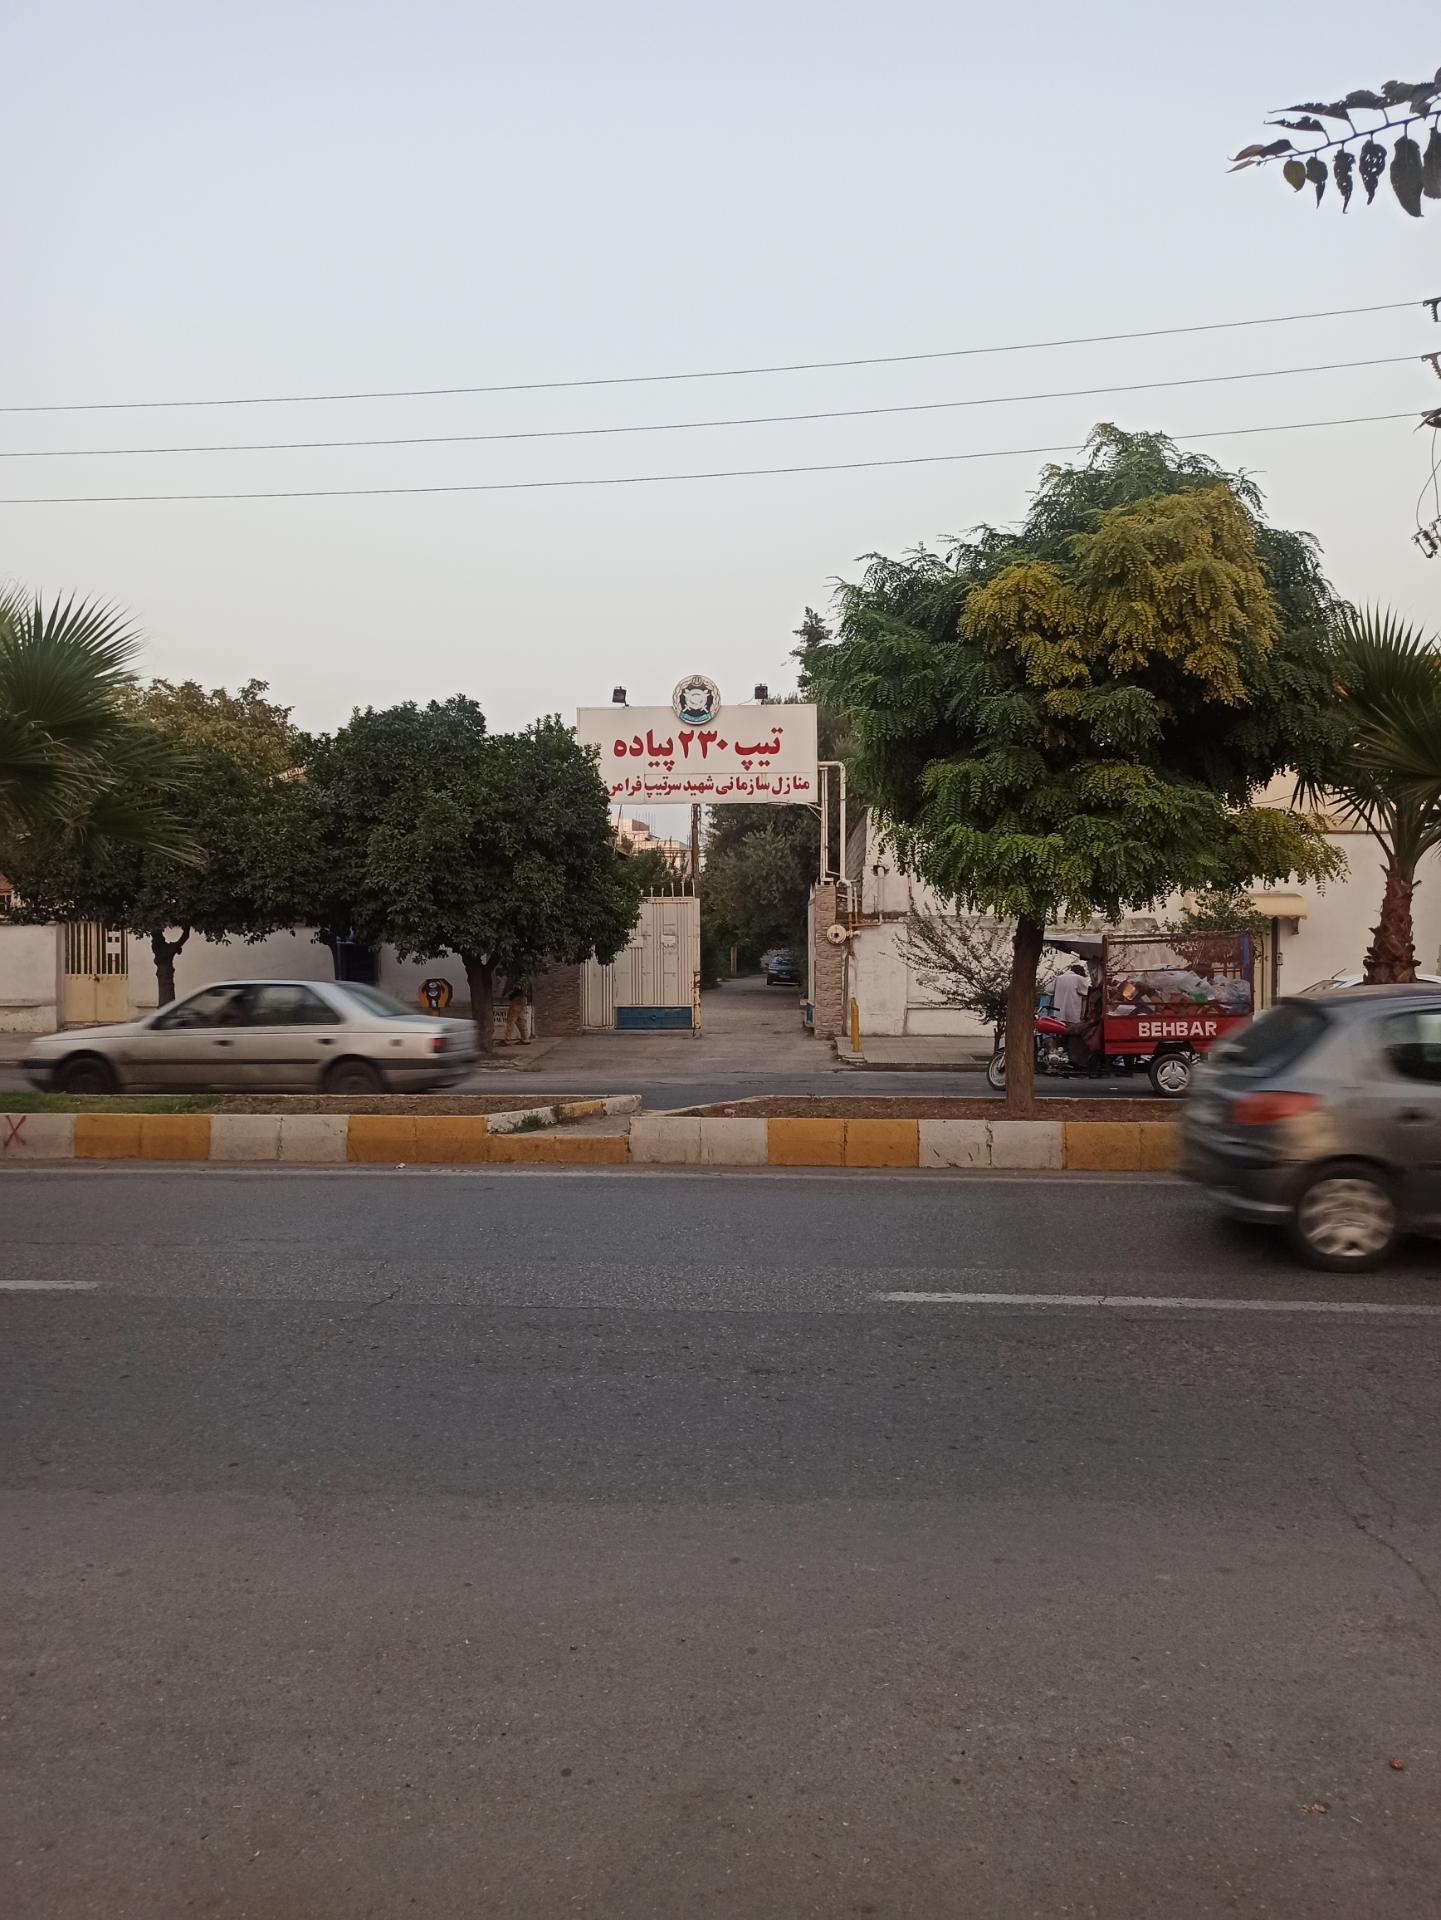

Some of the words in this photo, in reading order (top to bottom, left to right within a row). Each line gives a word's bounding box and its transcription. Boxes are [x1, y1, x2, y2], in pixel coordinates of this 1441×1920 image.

[613, 728, 675, 772] پیاده
[678, 729, 729, 759] ۲۳۰
[735, 727, 784, 771] تیپ
[603, 775, 643, 797] فرامر
[644, 775, 682, 799] سرتیپ
[683, 775, 715, 797] شهید
[715, 775, 770, 796] سازمانی
[771, 775, 811, 796] منازل
[1138, 1021, 1217, 1037] BEHBAR
